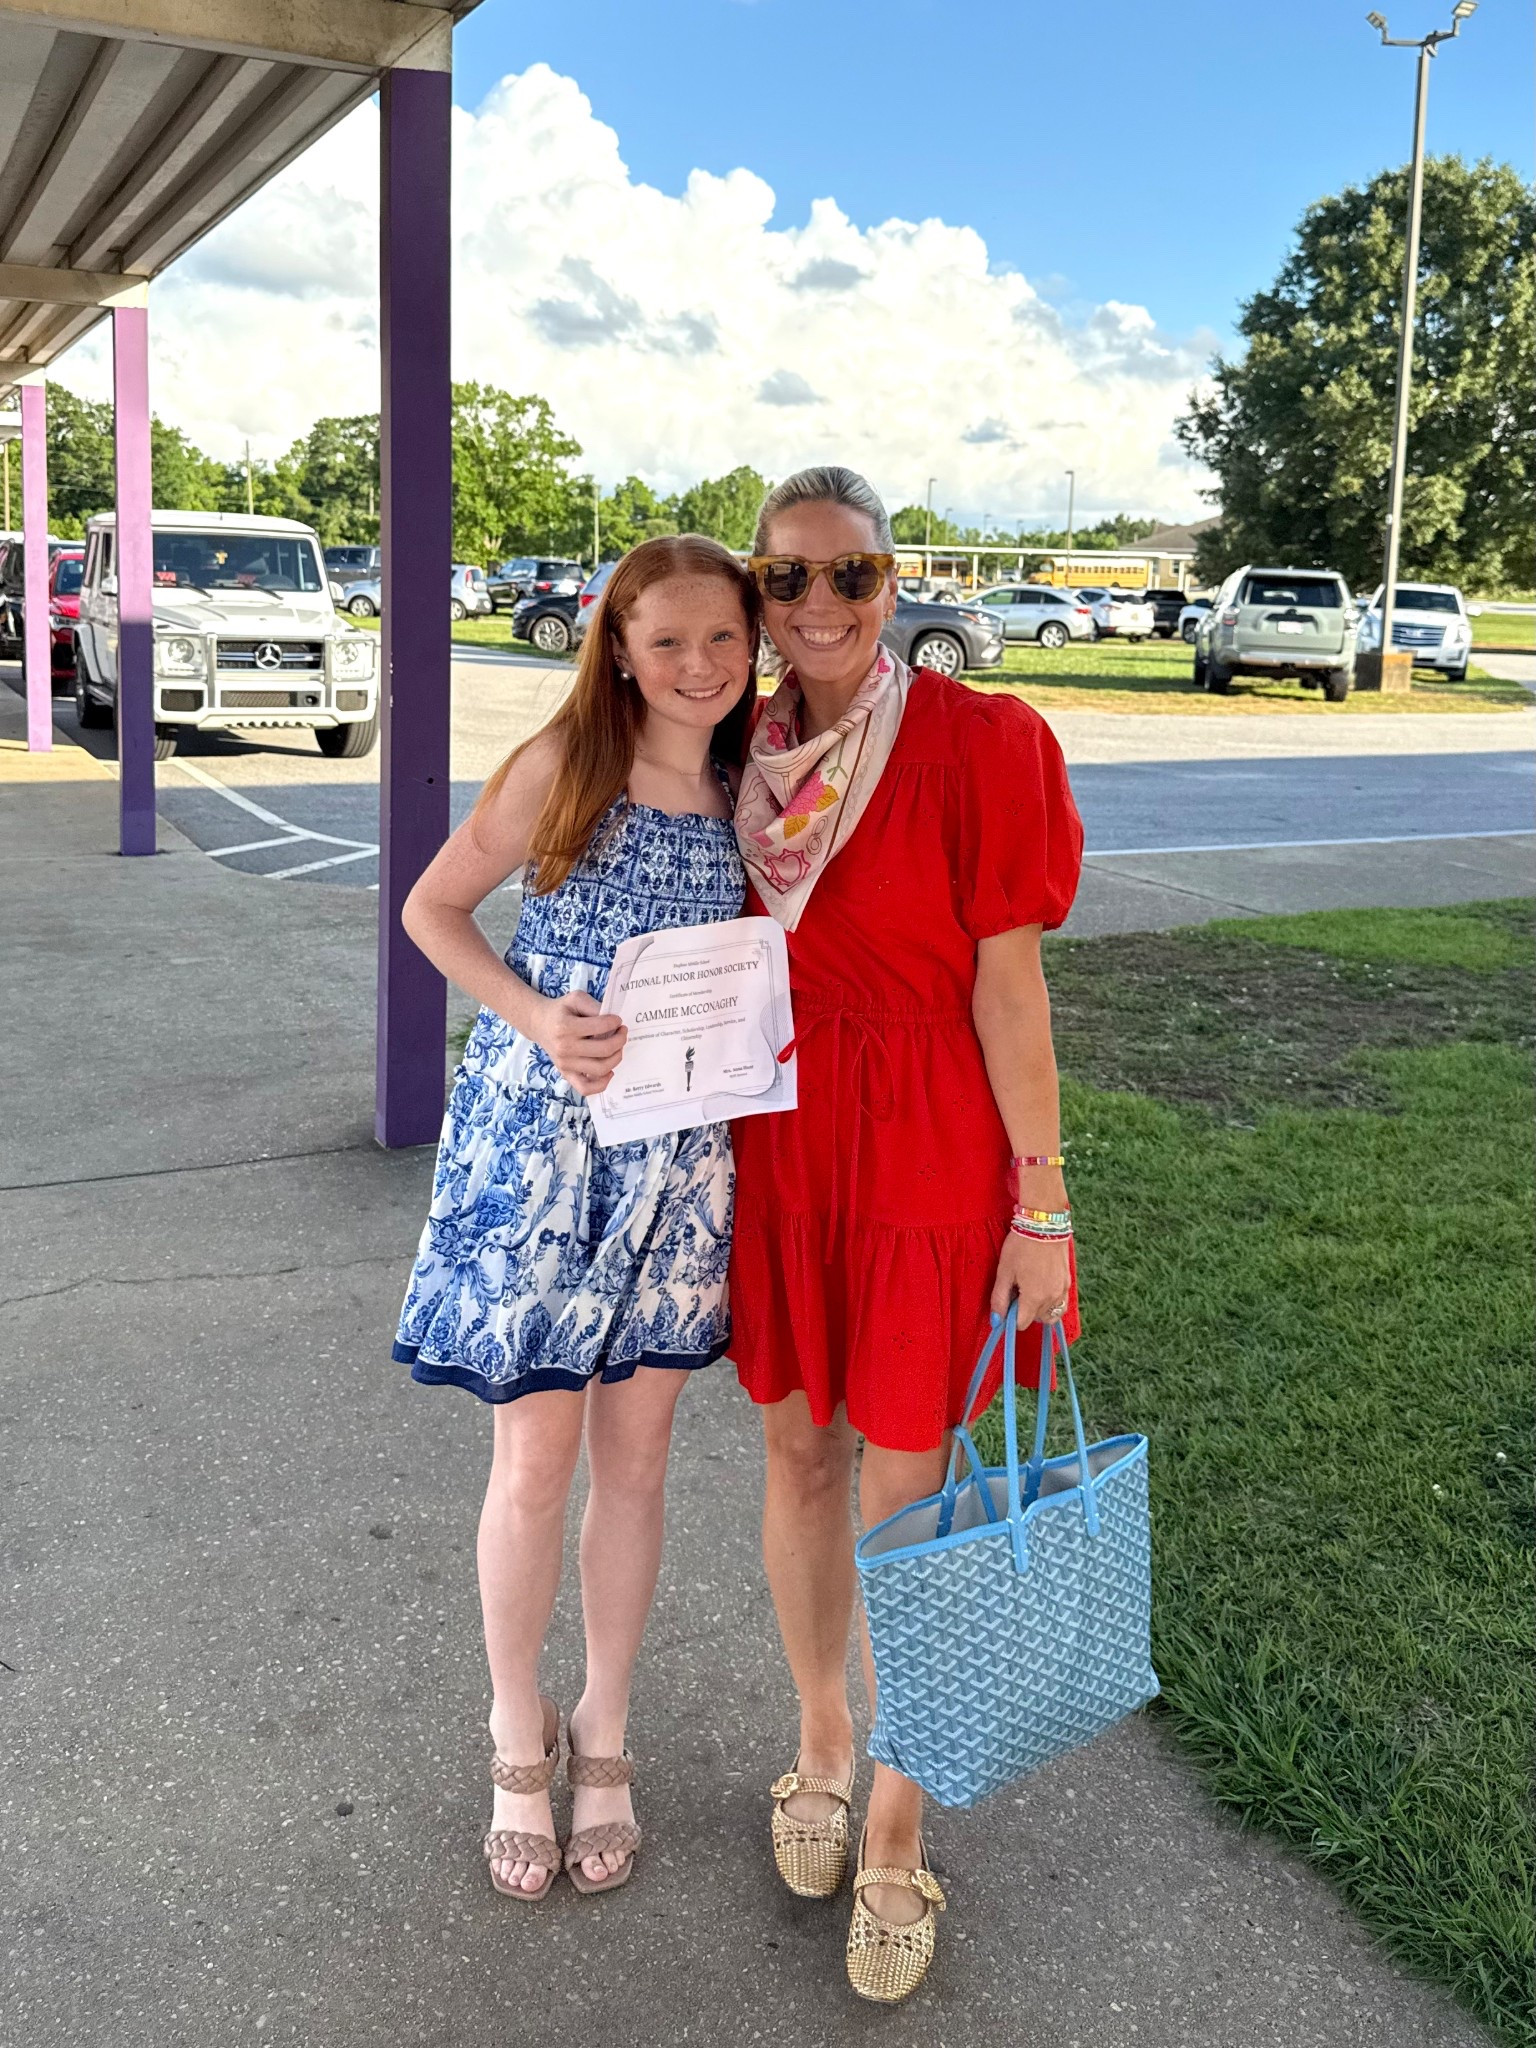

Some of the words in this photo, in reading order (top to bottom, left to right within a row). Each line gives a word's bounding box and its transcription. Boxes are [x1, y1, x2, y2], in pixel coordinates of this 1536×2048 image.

[619, 976, 661, 992] NATIONAL
[662, 971, 696, 986] JUNIOR
[696, 966, 723, 980] HONOR
[723, 960, 760, 974] SOCIETY
[635, 1007, 679, 1023] CAMMIE
[680, 995, 739, 1017] MCCONAGHY
